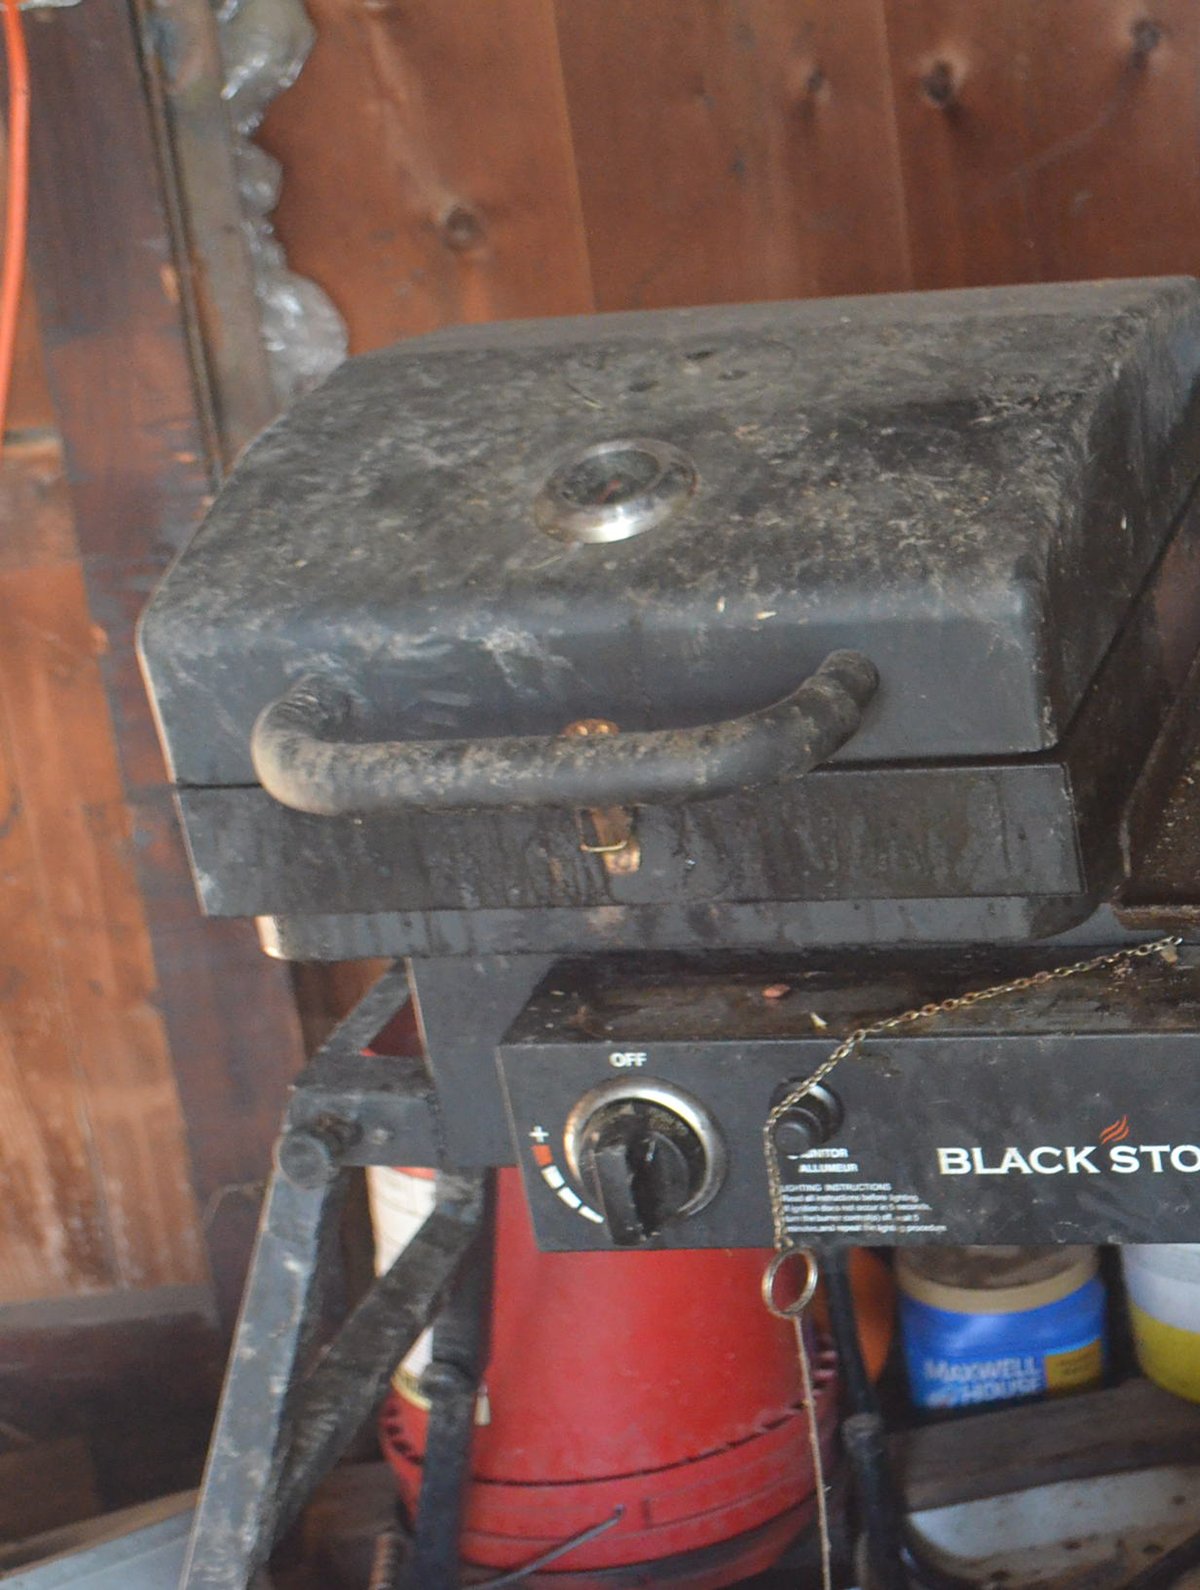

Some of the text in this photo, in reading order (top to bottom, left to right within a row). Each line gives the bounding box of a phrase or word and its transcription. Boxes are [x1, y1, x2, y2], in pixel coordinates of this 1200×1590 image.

[609, 1053, 647, 1067] OFF
[798, 1163, 859, 1173] ALLUMEUR
[823, 1182, 892, 1192] INSTRUCTIONS
[923, 1356, 1040, 1383] MAXWELL
